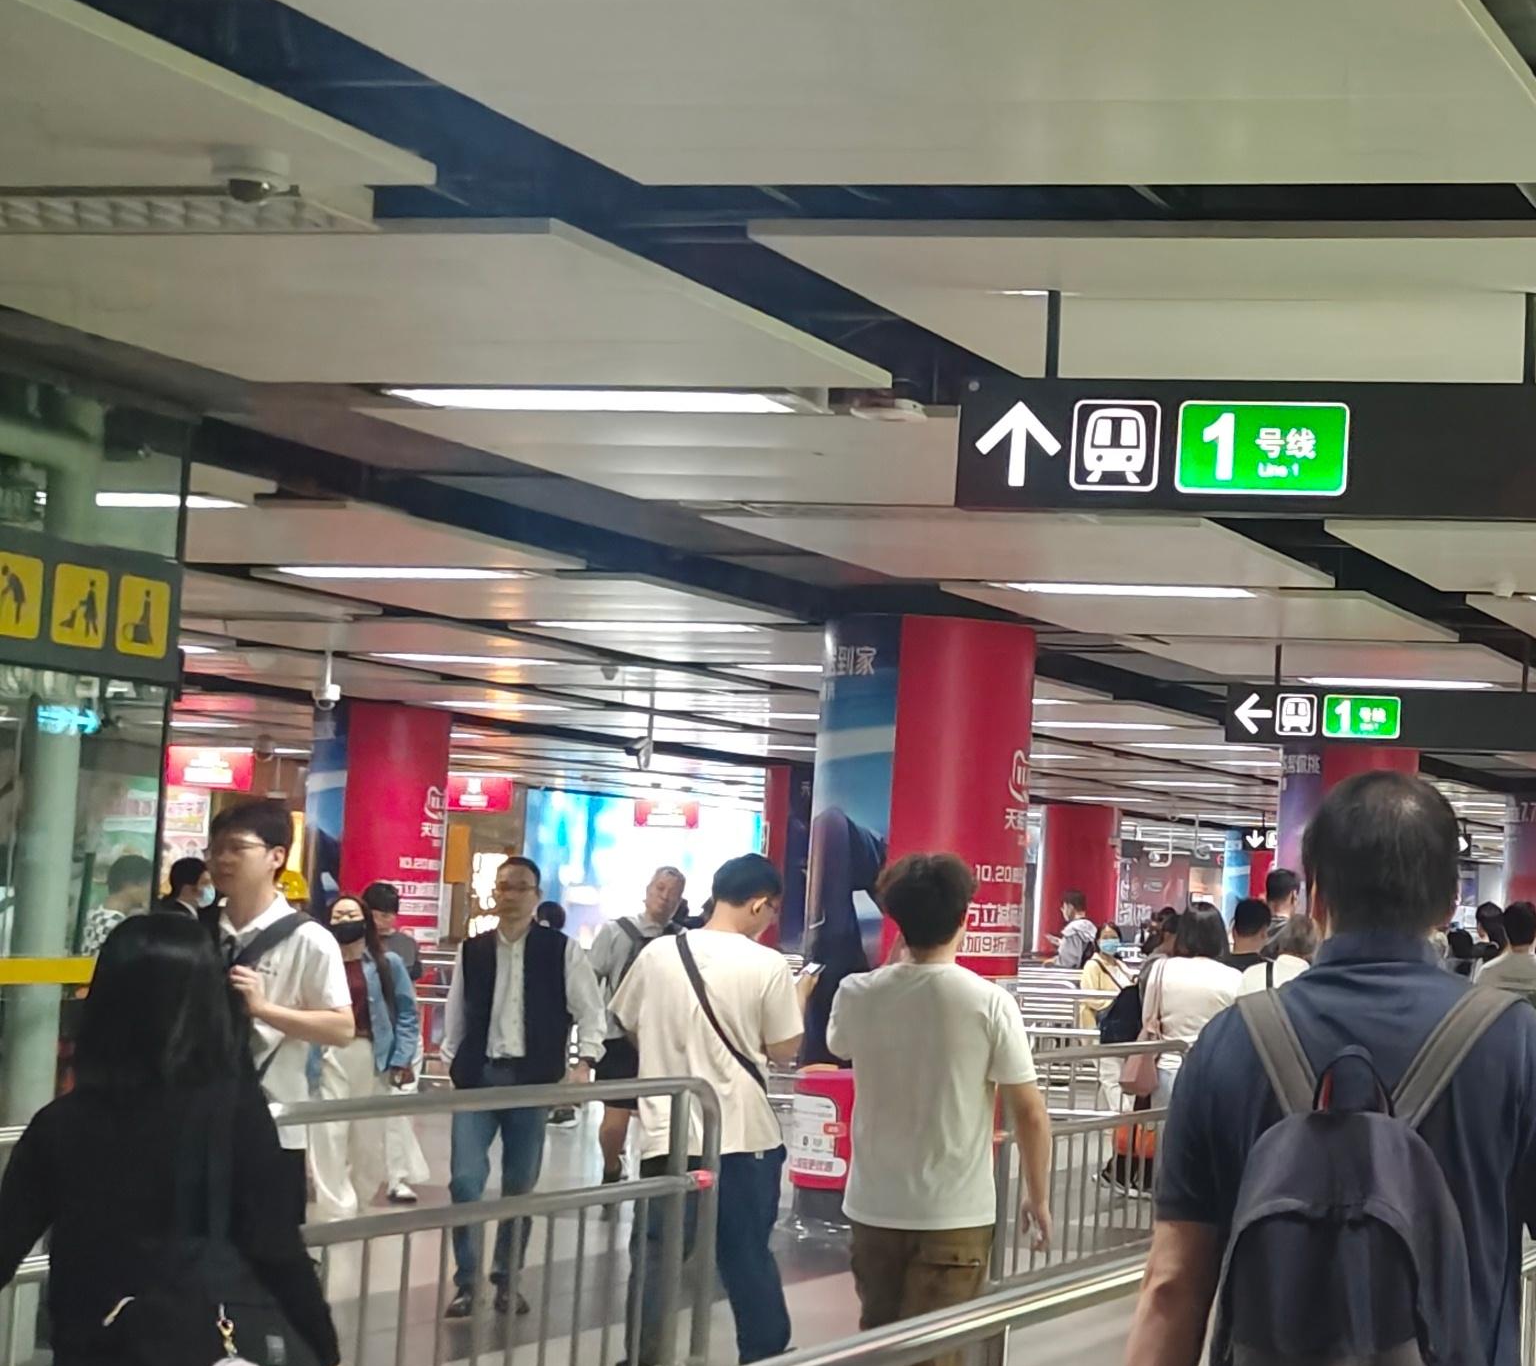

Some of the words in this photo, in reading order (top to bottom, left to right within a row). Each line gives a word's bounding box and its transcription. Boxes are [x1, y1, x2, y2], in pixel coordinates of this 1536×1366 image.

[1203, 412, 1235, 481] 1
[1255, 427, 1317, 460] 号线
[1334, 699, 1351, 732] 1
